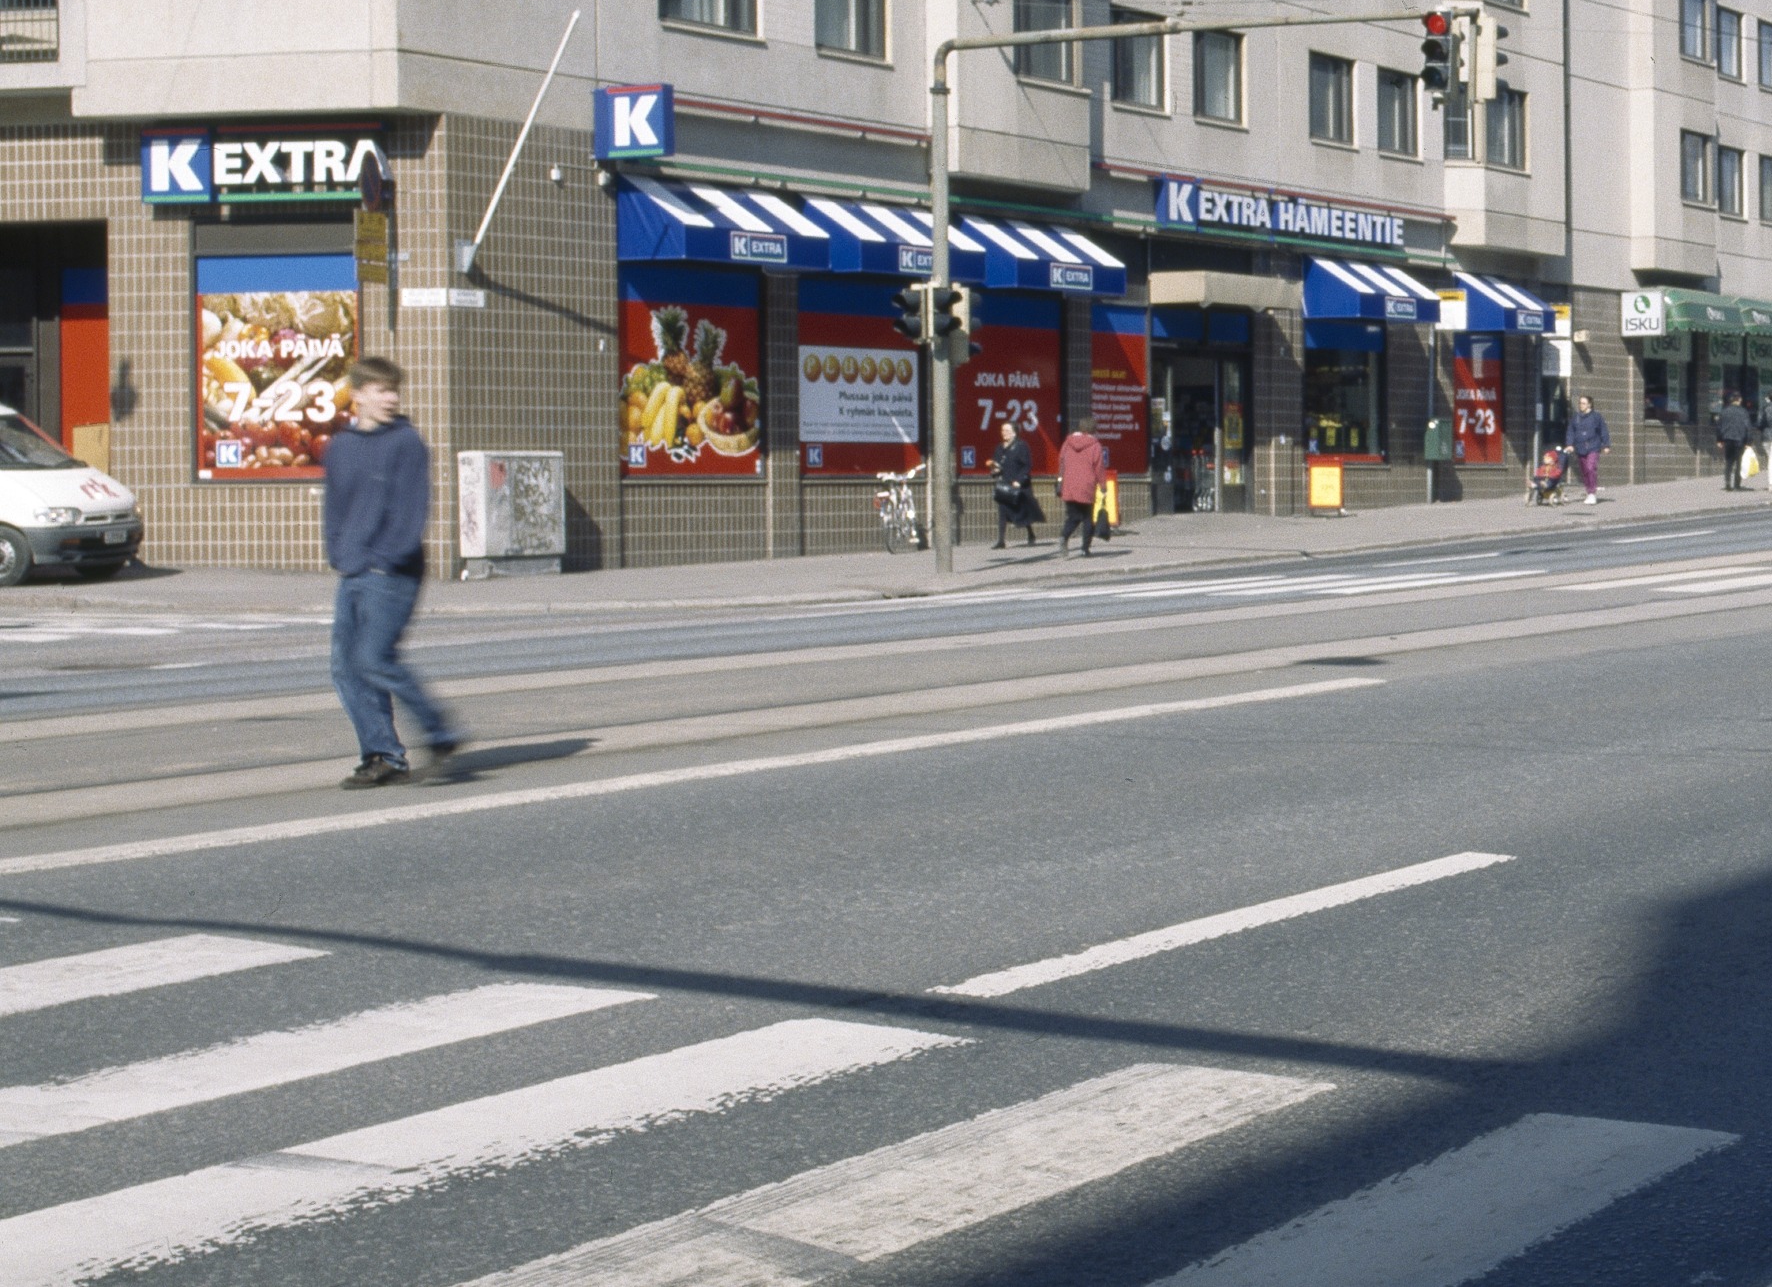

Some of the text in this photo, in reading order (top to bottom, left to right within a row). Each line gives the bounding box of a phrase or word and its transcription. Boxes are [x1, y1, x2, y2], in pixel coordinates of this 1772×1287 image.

[614, 95, 659, 147] K
[150, 138, 384, 192] K EXTRA
[1168, 181, 1404, 245] K EXTRA HÄMEENTIE
[734, 237, 782, 255] K EXTRA
[902, 251, 933, 268] K EXT
[1052, 266, 1090, 282] K EXTRA
[1386, 300, 1395, 314] K
[1625, 317, 1660, 331] ISKU
[213, 333, 345, 359] JOKA PÄIVÄ
[974, 370, 1040, 389] JOKA PÄIVÄ
[223, 380, 337, 423] 7-23
[977, 398, 1039, 432] 7-23
[1457, 408, 1496, 435] 7-23
[219, 444, 238, 464] K
[629, 446, 643, 463] K
[808, 447, 820, 466] K
[963, 450, 974, 465] K
